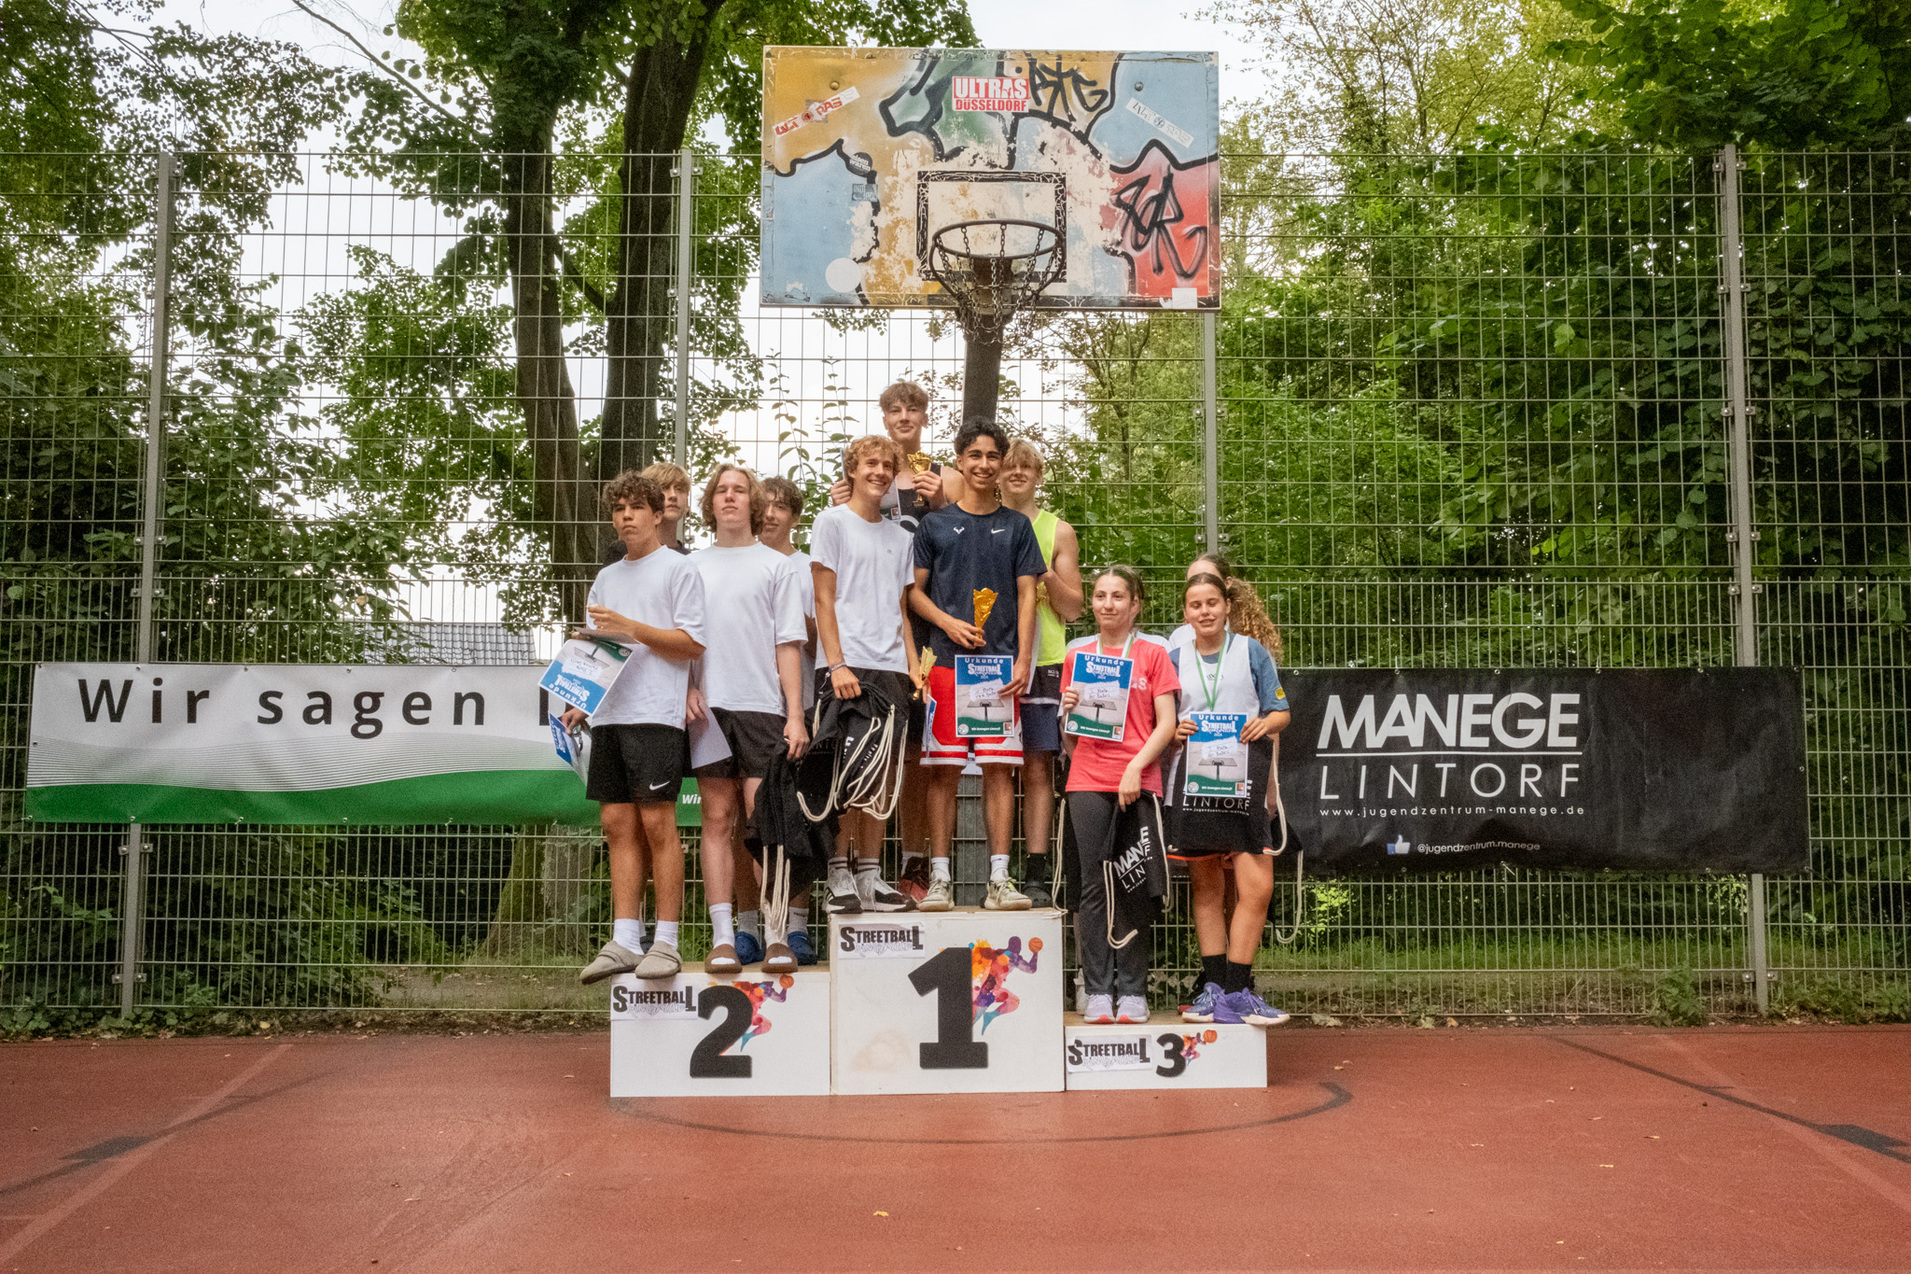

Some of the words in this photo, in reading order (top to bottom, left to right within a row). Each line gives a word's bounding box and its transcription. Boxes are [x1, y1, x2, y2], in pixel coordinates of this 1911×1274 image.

[954, 77, 1028, 99] ULTRAS
[955, 98, 1027, 112] DÜSSELDORF
[1084, 654, 1125, 667] Urkunde
[77, 676, 211, 725] Wir
[257, 689, 485, 740] sagen
[548, 683, 588, 710] Urkunde
[1198, 713, 1240, 721] Urkunde
[1316, 692, 1581, 750] MANEGE
[1319, 762, 1580, 800] LINTORF
[682, 793, 702, 805] Wir
[1182, 795, 1250, 811] LINTORF
[1319, 806, 1585, 818] www.jugendzentrum-manege.de
[1417, 839, 1541, 855] @jugendzentrum.manege
[840, 925, 924, 952] STREETBALL
[612, 985, 697, 1013] STREETBALL
[907, 947, 989, 1070] 1
[689, 984, 754, 1079] 2
[1067, 1037, 1151, 1066] STREETBALL
[1155, 1032, 1187, 1078] 3
